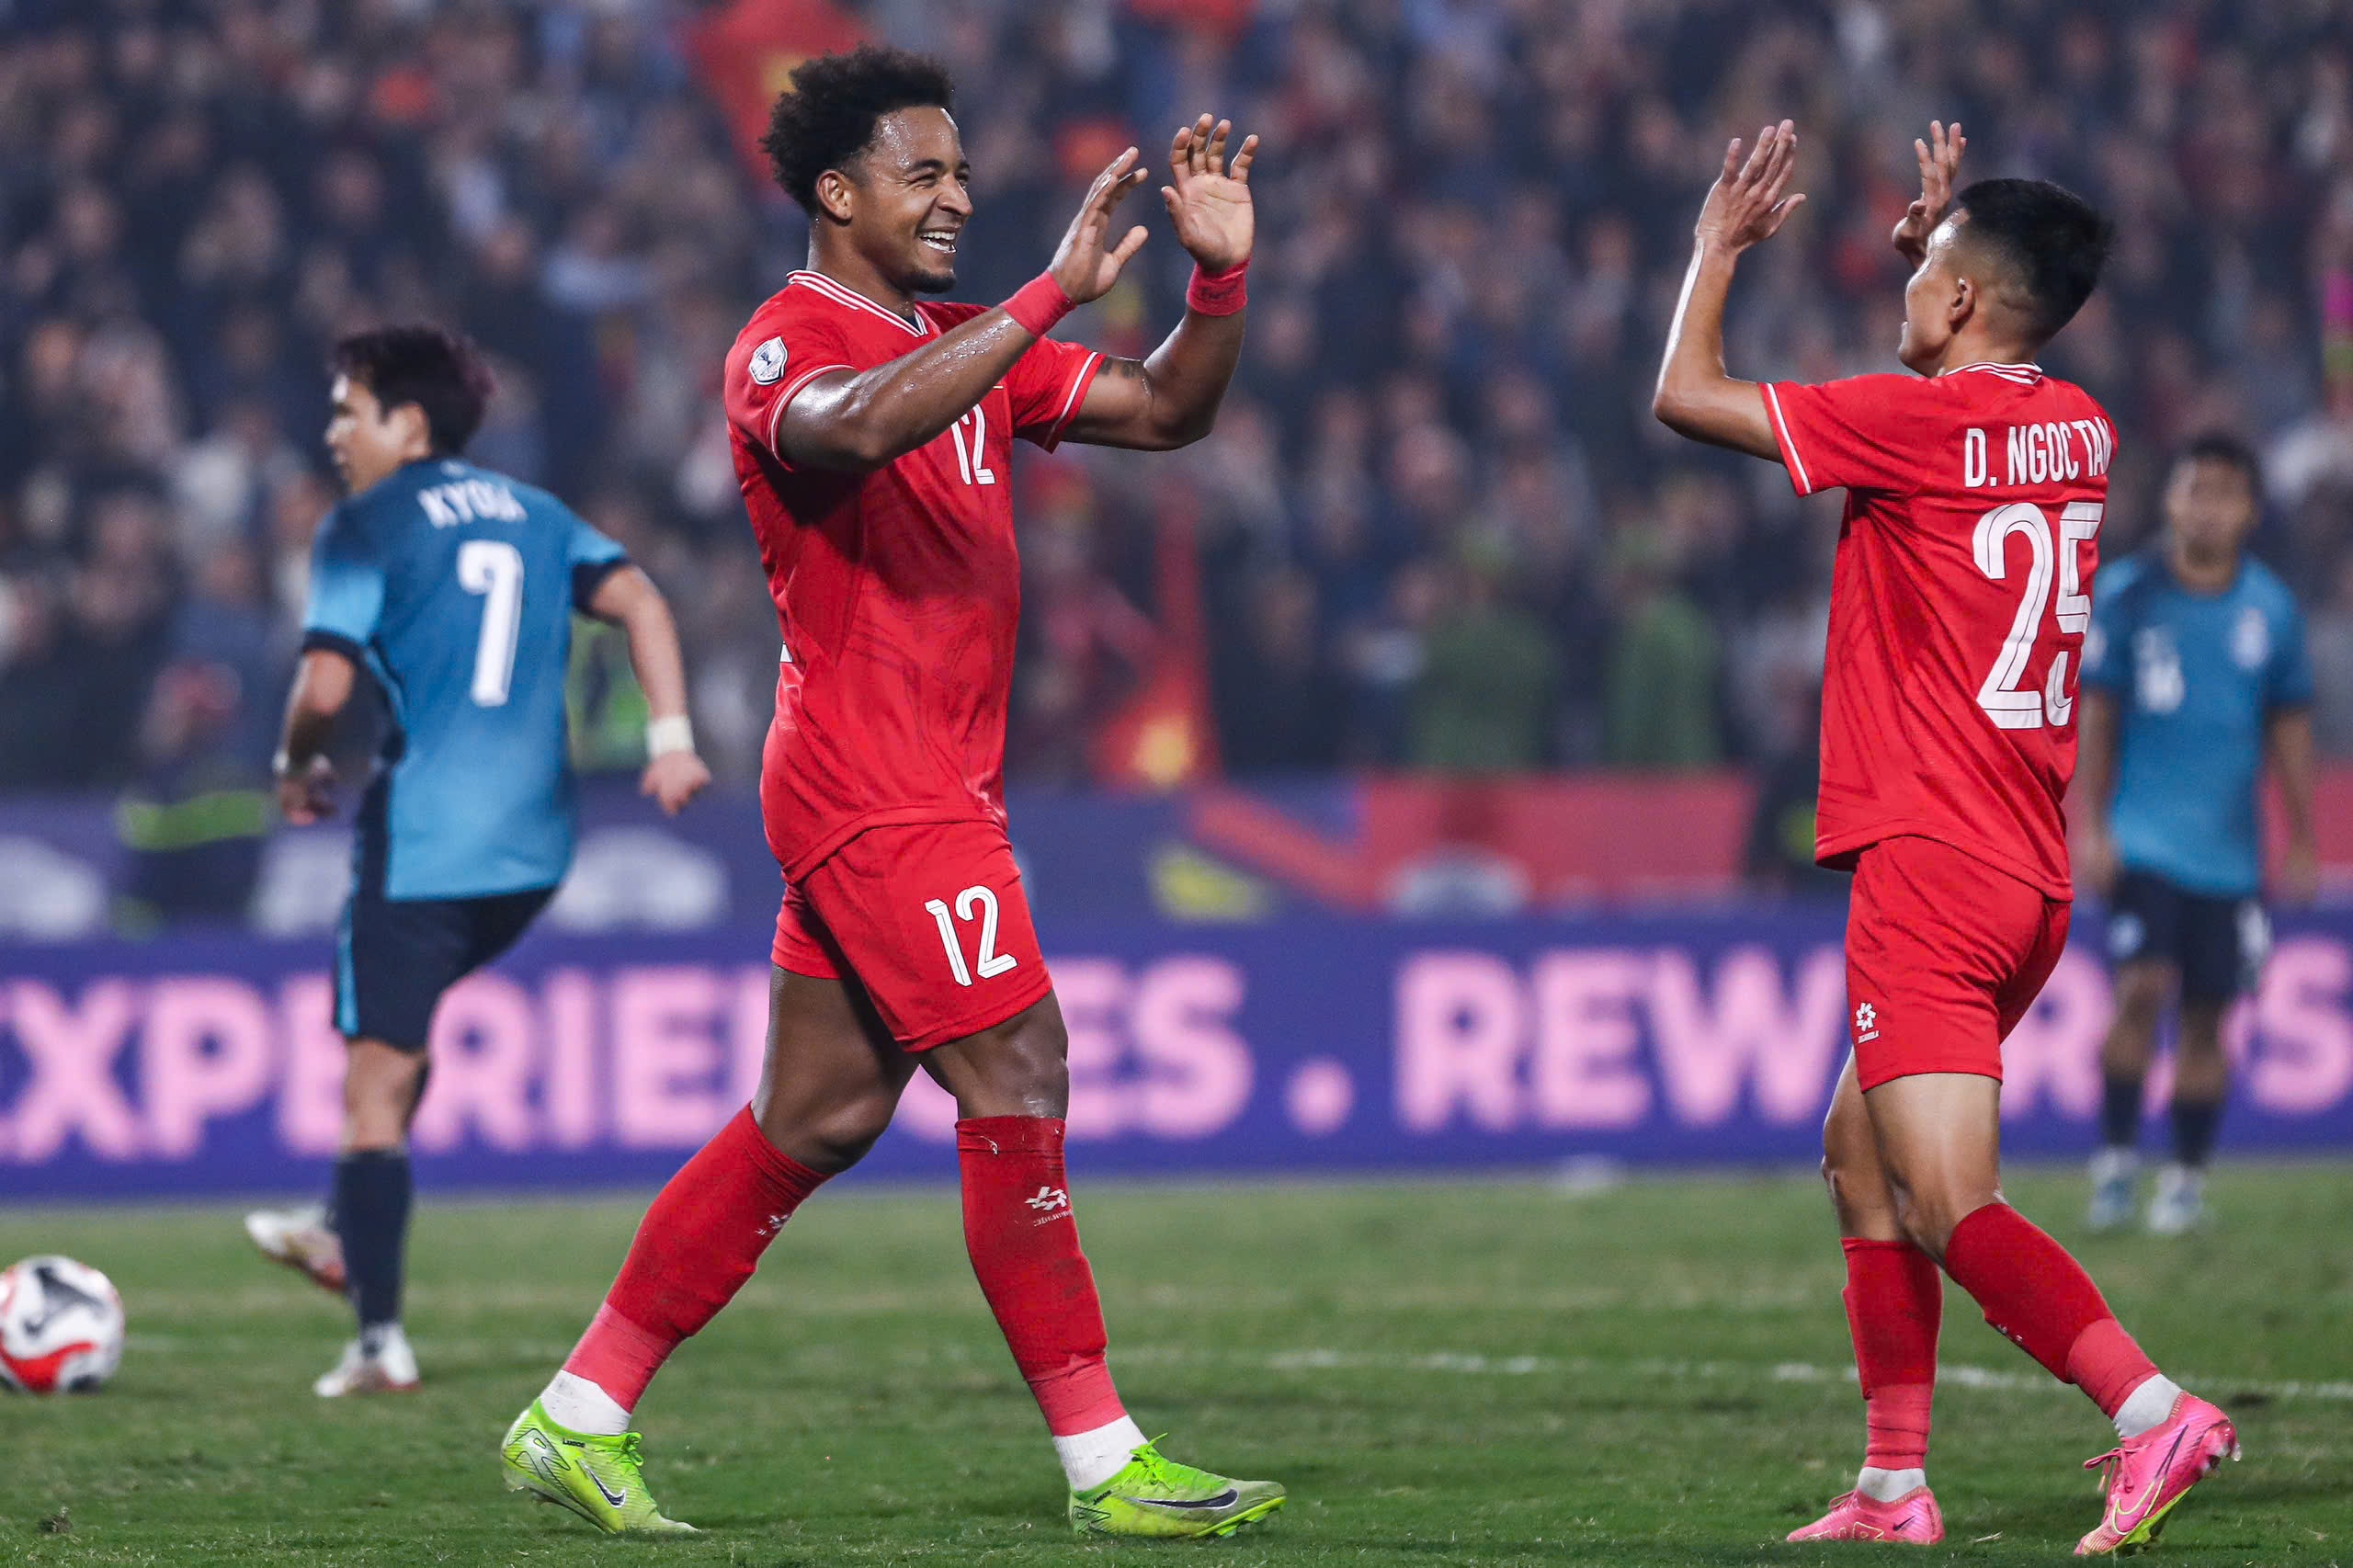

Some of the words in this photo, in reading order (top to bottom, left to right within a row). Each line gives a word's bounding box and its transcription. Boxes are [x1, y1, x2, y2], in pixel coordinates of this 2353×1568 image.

[950, 403, 995, 485] 12
[1964, 427, 1998, 488] D.
[2006, 421, 2080, 485] NGOC
[456, 539, 525, 708] 7
[1972, 501, 2104, 730] 25
[924, 884, 1018, 987] 12
[1395, 936, 2353, 1132] REWRS
